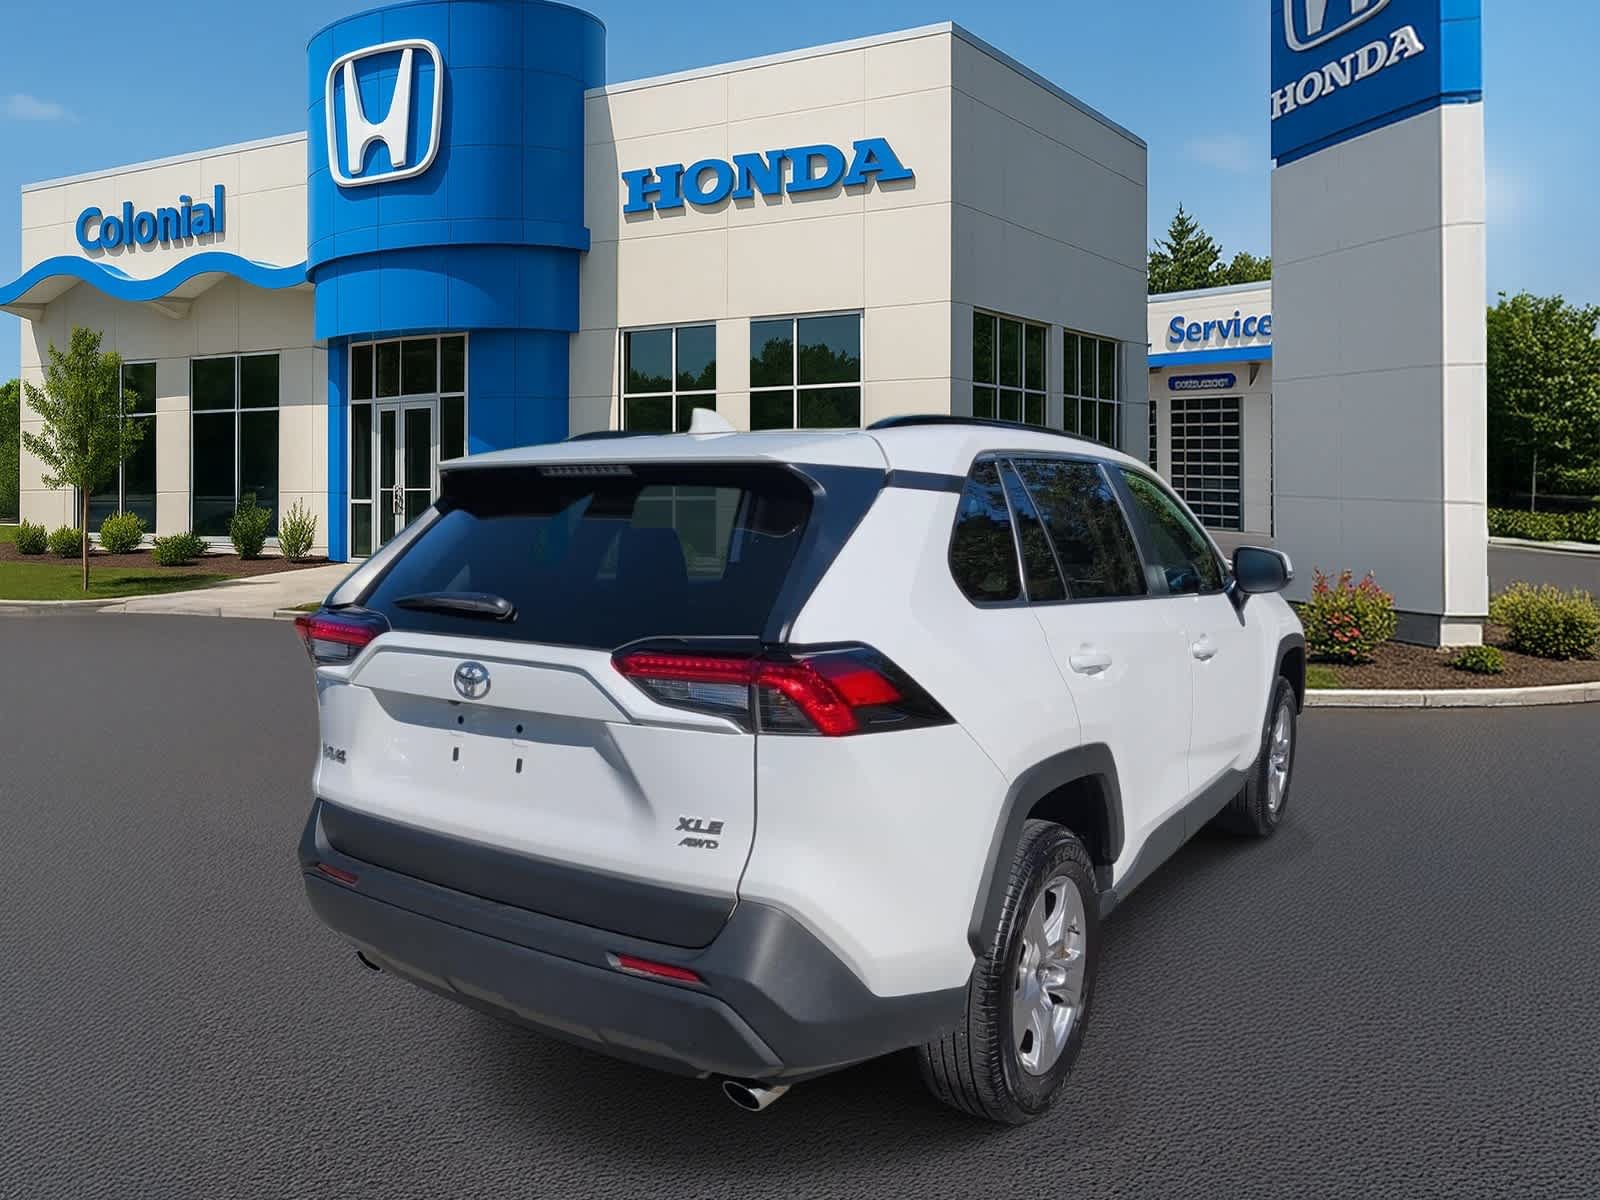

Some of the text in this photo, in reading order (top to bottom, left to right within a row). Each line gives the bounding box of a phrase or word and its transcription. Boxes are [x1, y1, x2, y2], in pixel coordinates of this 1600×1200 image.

[1271, 25, 1424, 120] HONDA
[621, 137, 913, 213] HONDA
[76, 184, 225, 250] Colonial
[1169, 310, 1271, 343] Service
[675, 817, 724, 835] XLE
